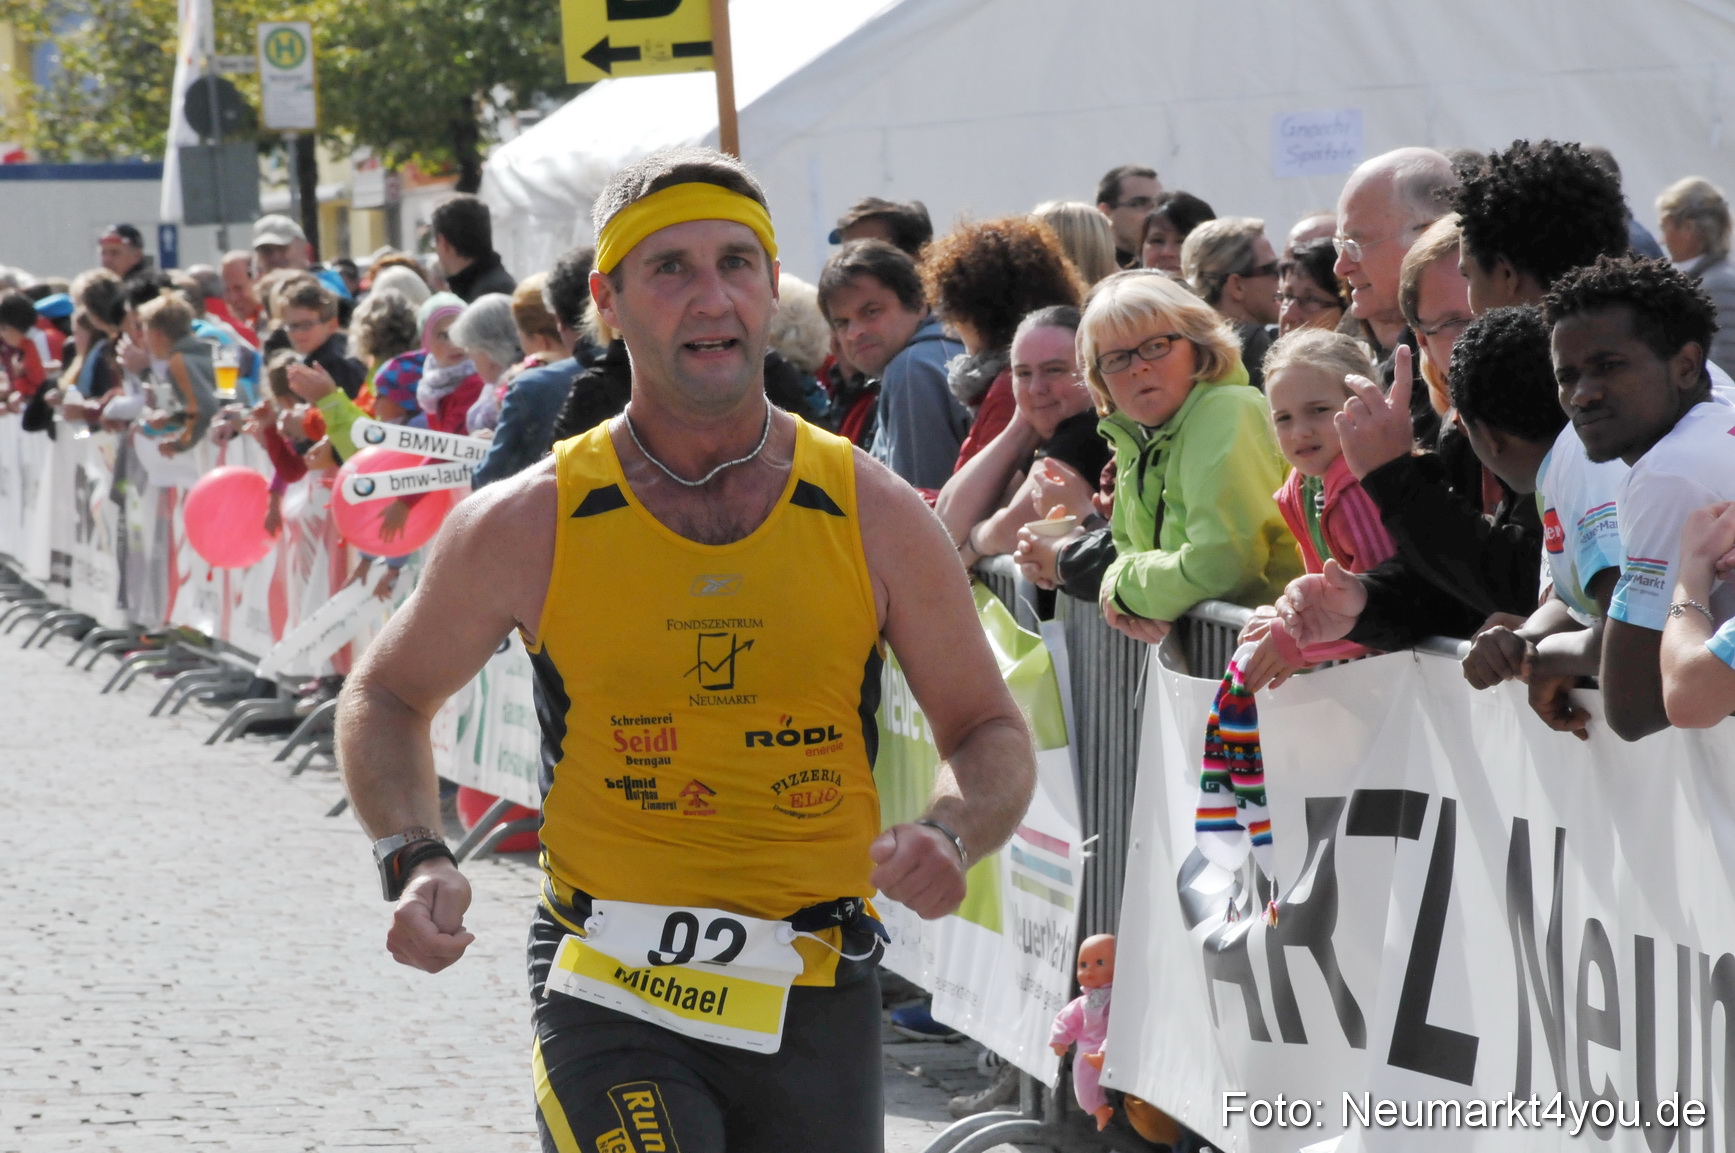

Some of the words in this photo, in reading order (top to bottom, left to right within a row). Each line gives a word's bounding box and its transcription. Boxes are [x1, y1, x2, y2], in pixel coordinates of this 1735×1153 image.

[399, 431, 449, 454] BMW
[667, 618, 764, 631] FONDSZENTRUM
[689, 694, 757, 707] NEUMARKT
[610, 713, 673, 727] Schreinerei
[613, 727, 678, 753] Seidl
[805, 741, 844, 758] energie
[626, 755, 671, 769] Berngau
[770, 769, 843, 796] PIZZERIA
[789, 787, 838, 808] ELIO
[613, 966, 729, 1016] Michael
